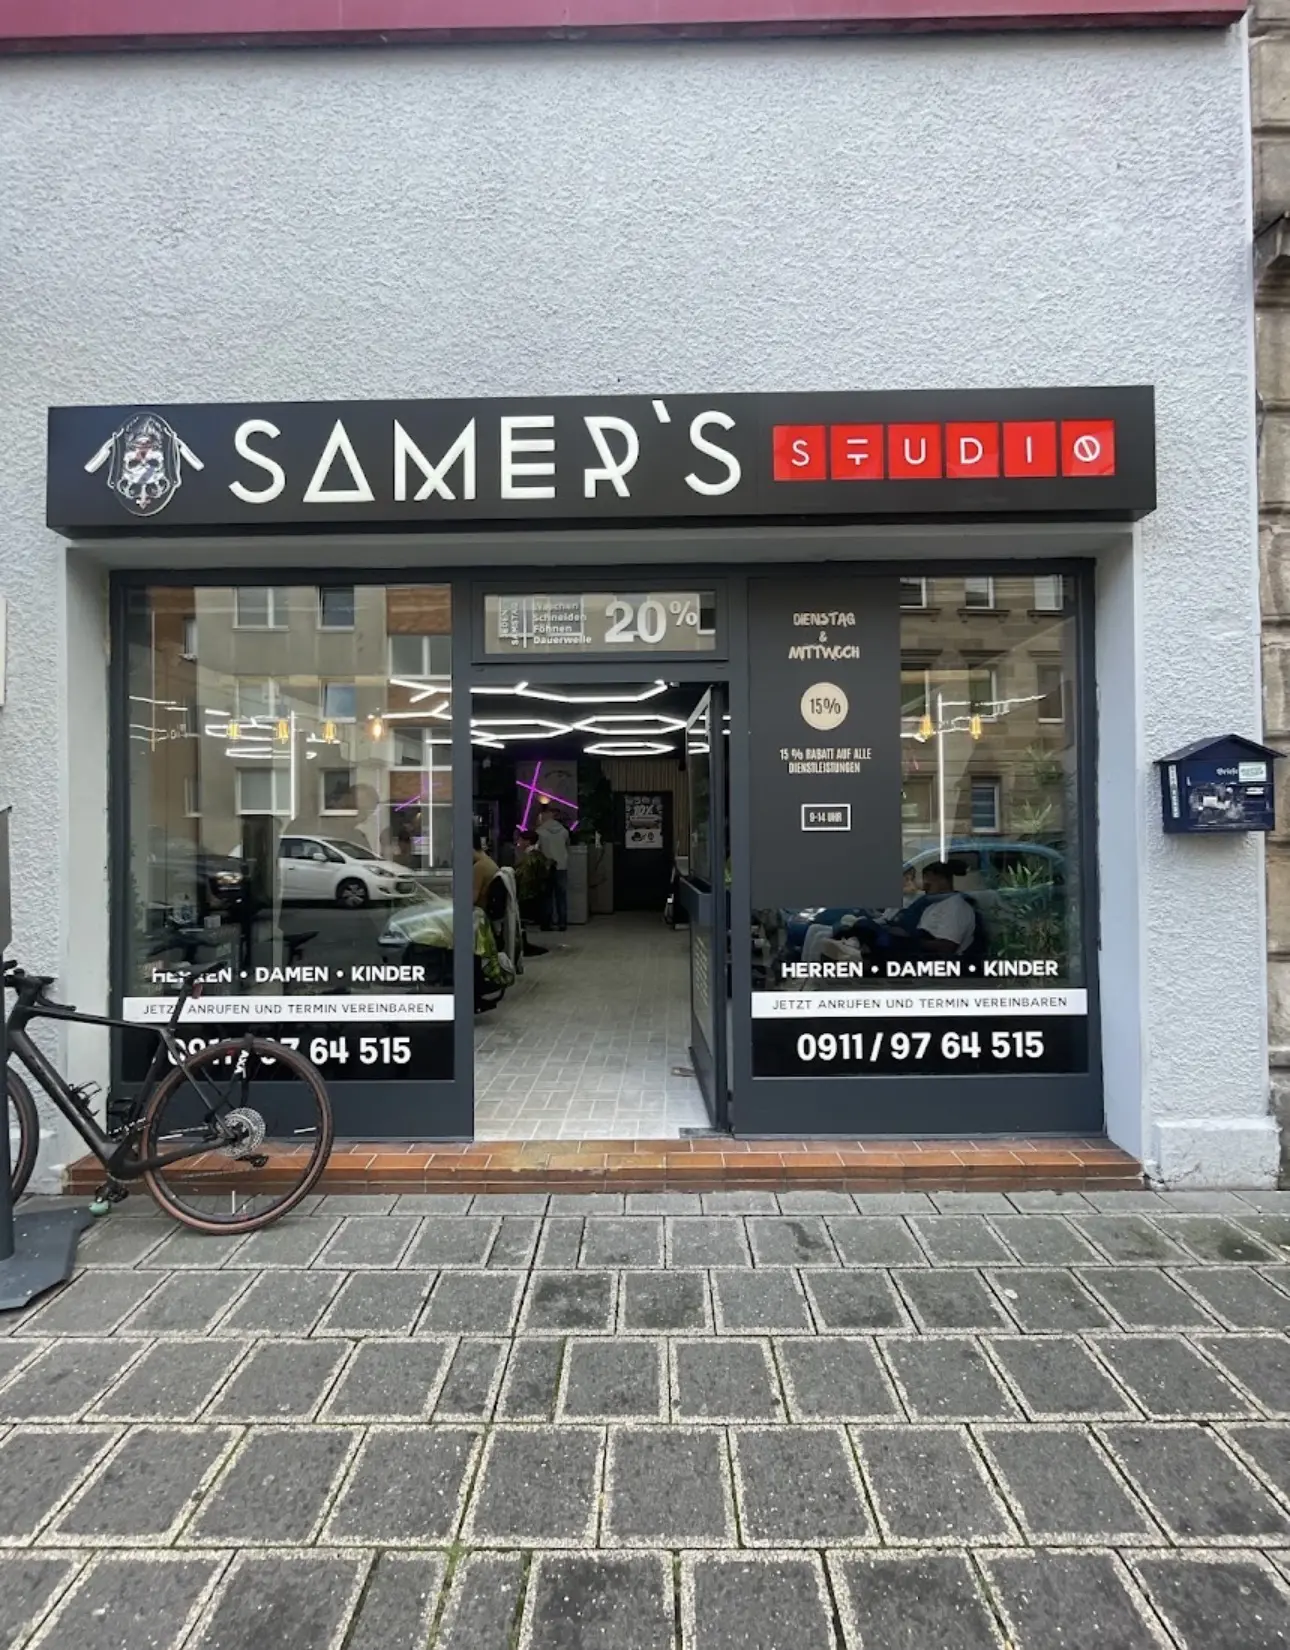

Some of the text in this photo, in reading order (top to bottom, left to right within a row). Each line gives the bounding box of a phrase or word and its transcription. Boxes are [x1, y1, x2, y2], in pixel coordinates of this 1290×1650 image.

[228, 399, 1101, 504] SAMER'S STUDIO
[533, 613, 587, 622] Schneiden
[605, 600, 698, 644] 20%
[793, 611, 856, 627] DIENSTAG
[533, 624, 573, 633] Föhnen
[533, 635, 592, 645] Dauerwelle
[819, 630, 828, 643] &
[810, 698, 841, 715] 15%
[780, 748, 872, 761] 15 % RABATT AUF ALLE
[788, 761, 861, 774] DIENSTLEISTUNGEN
[827, 812, 842, 823] UHR
[152, 965, 425, 984] HEEN DAMEN KINDER
[781, 960, 1059, 978] HERREN DAMEN KINDER
[143, 1002, 434, 1015] JETZ ANRUFEN UND TERMIN VEREINBAREN
[772, 997, 1068, 1010] JETZT ANRUFEN UND TERMIN VEREINBAREN
[310, 1037, 349, 1065] 64
[359, 1037, 412, 1064] 515
[941, 1031, 981, 1059] 64
[991, 1031, 1044, 1058] 515
